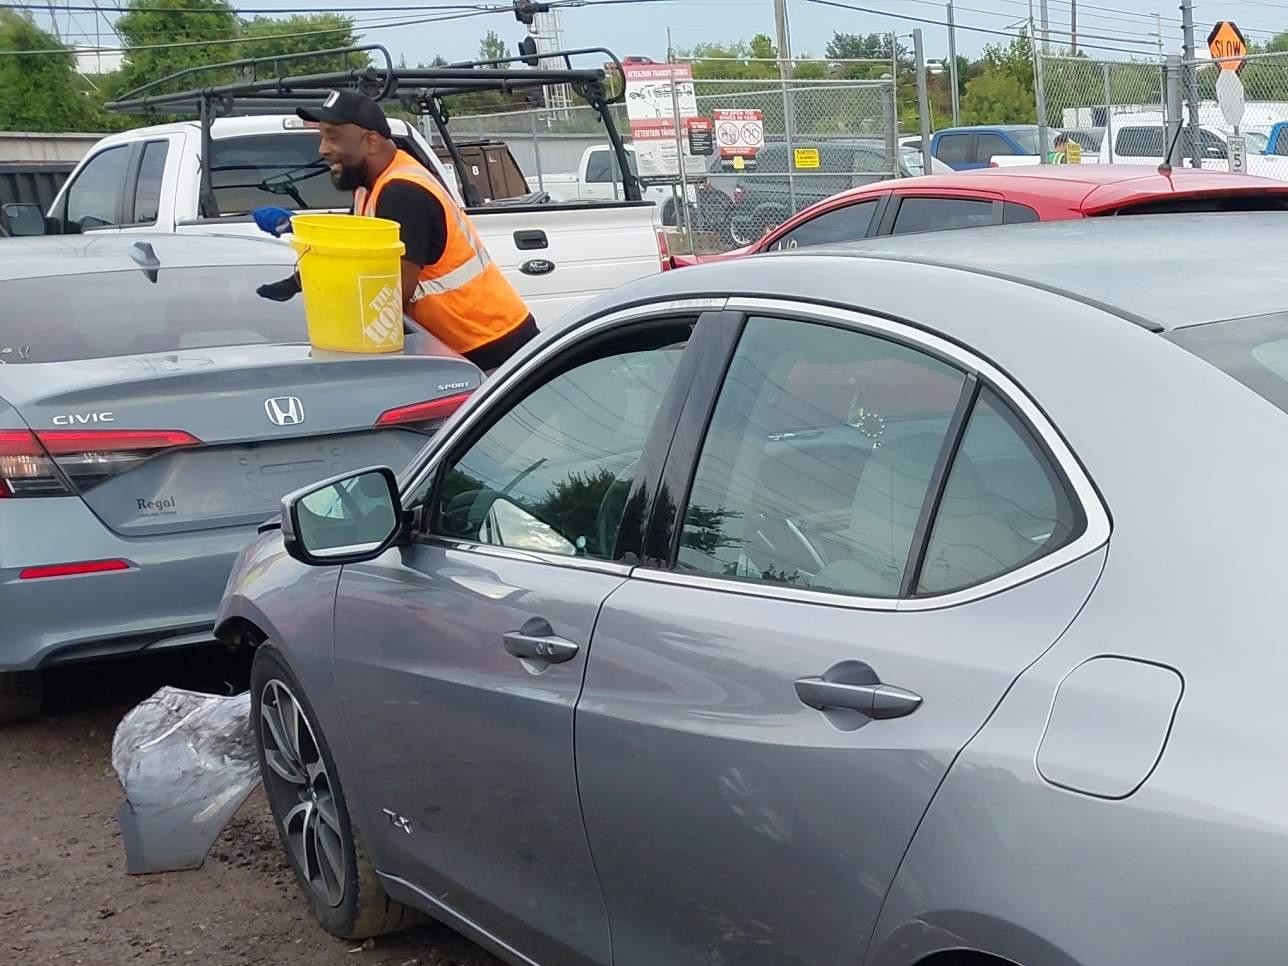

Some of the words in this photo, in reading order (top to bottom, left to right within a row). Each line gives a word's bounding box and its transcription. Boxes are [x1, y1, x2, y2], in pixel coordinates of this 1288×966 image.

[1215, 39, 1241, 58] SLOW
[1234, 153, 1242, 167] 5
[472, 165, 480, 176] 8
[528, 261, 550, 272] Ford
[437, 381, 471, 391] SPORT
[52, 412, 115, 426] CIVIC
[136, 496, 176, 512] Regal
